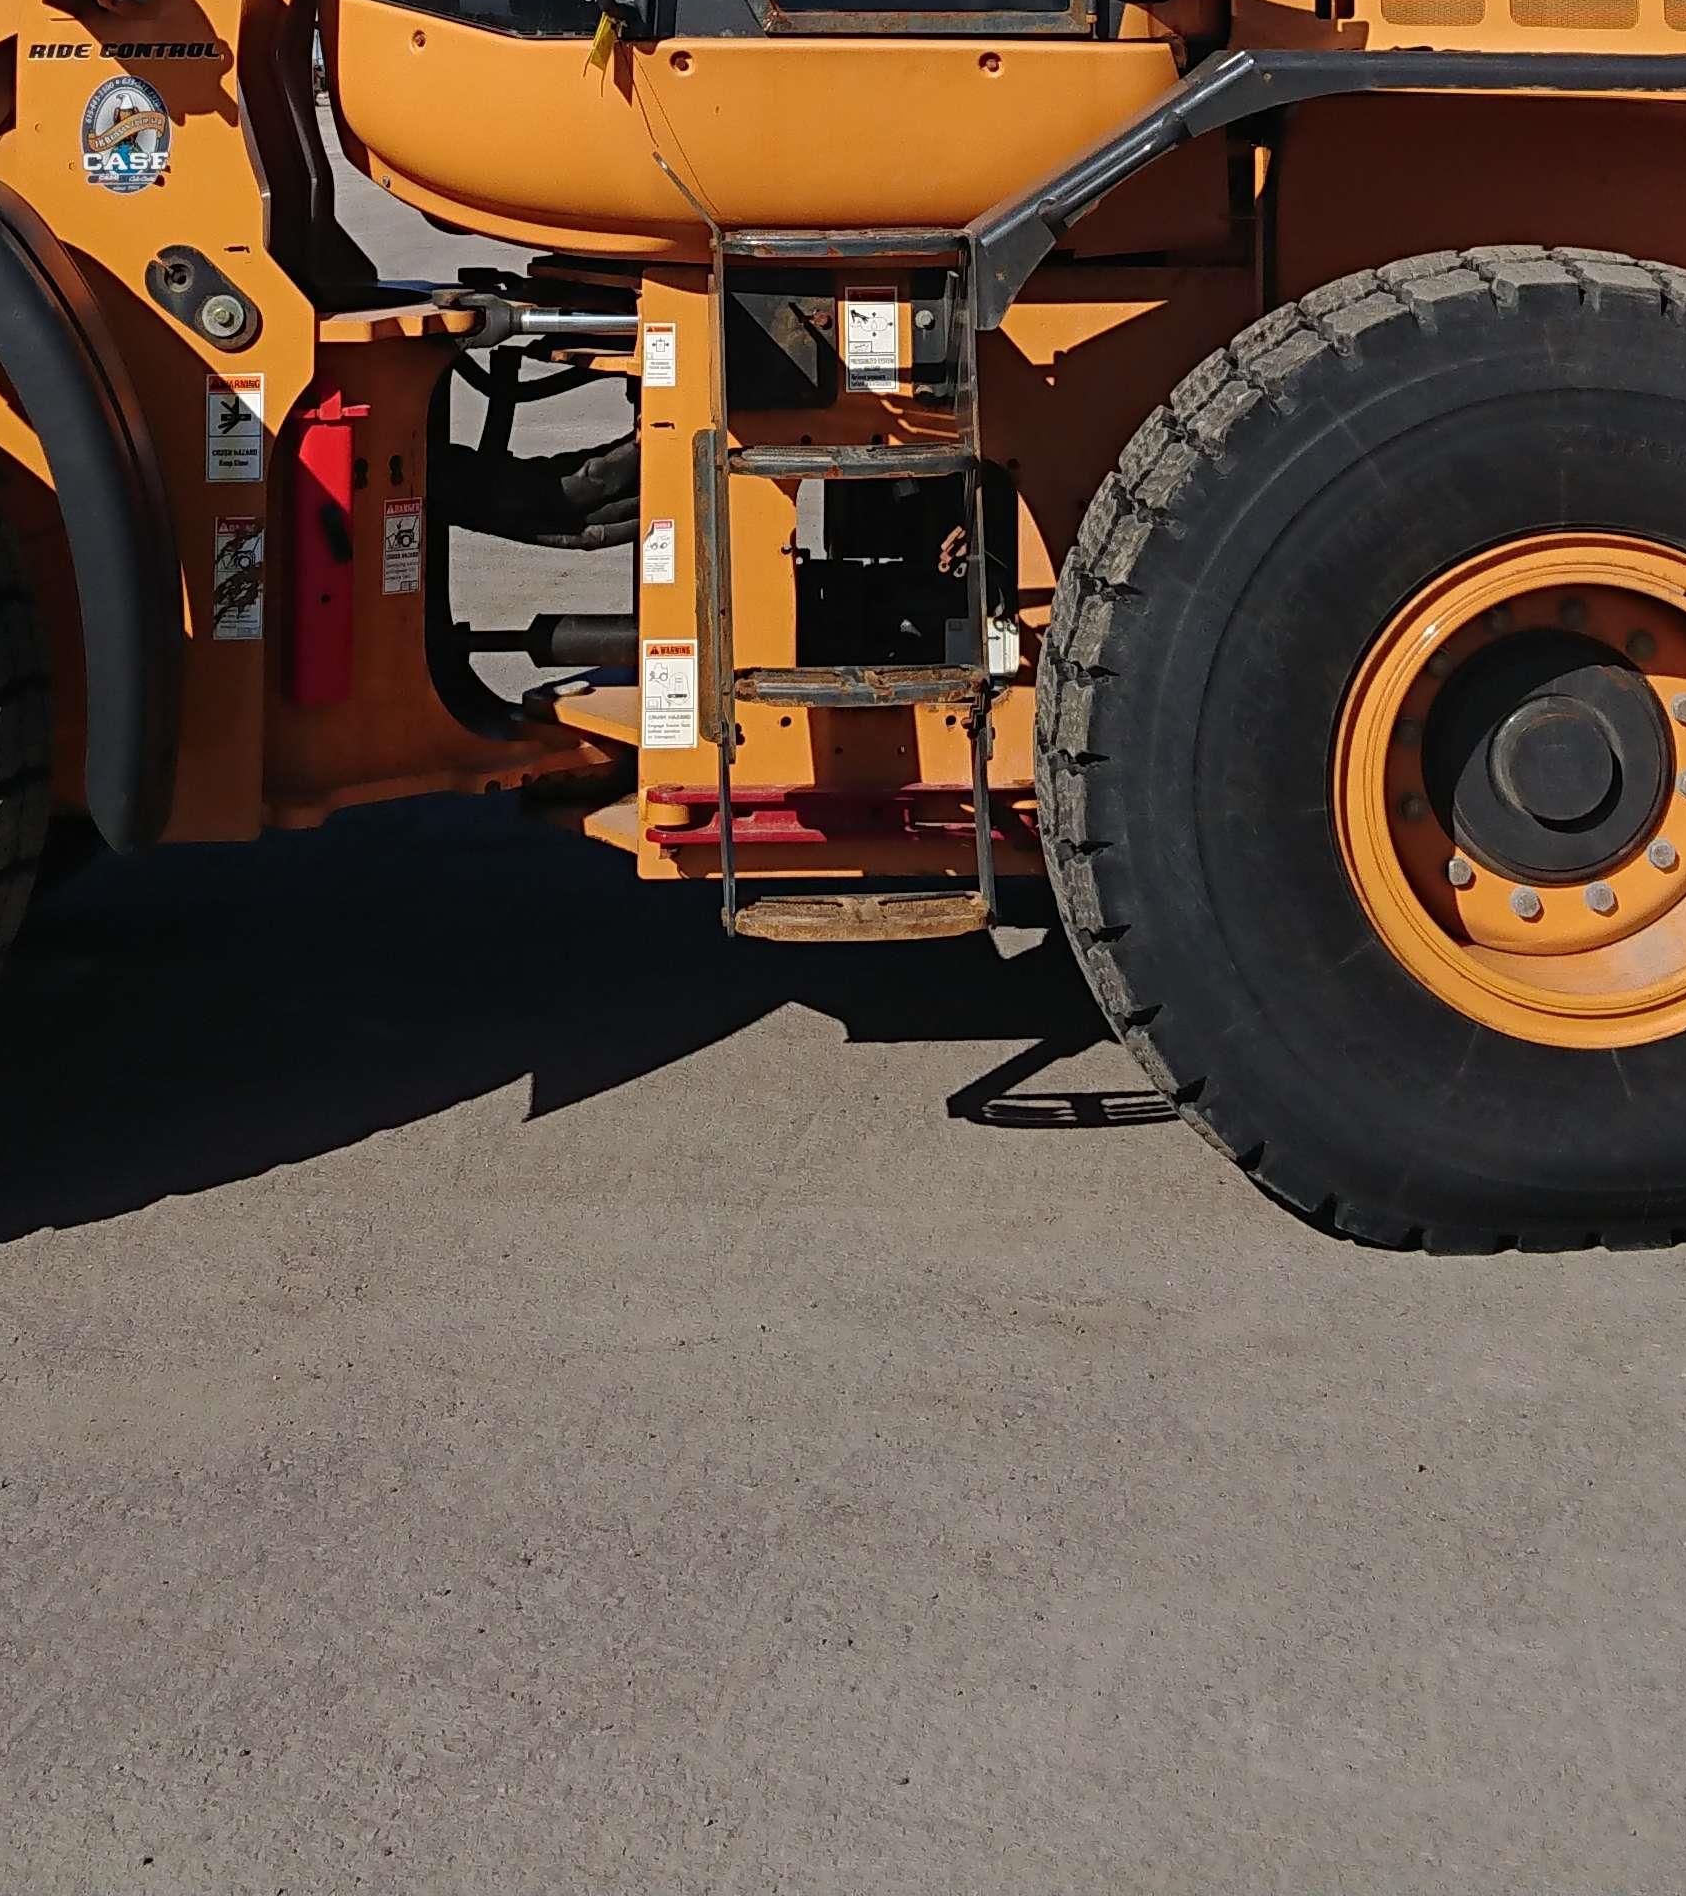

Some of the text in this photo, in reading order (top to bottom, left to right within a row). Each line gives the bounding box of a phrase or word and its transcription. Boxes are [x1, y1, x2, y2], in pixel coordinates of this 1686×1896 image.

[28, 43, 220, 61] RIDE CONTROL
[83, 152, 169, 171] CASE
[659, 645, 691, 655] WARNING
